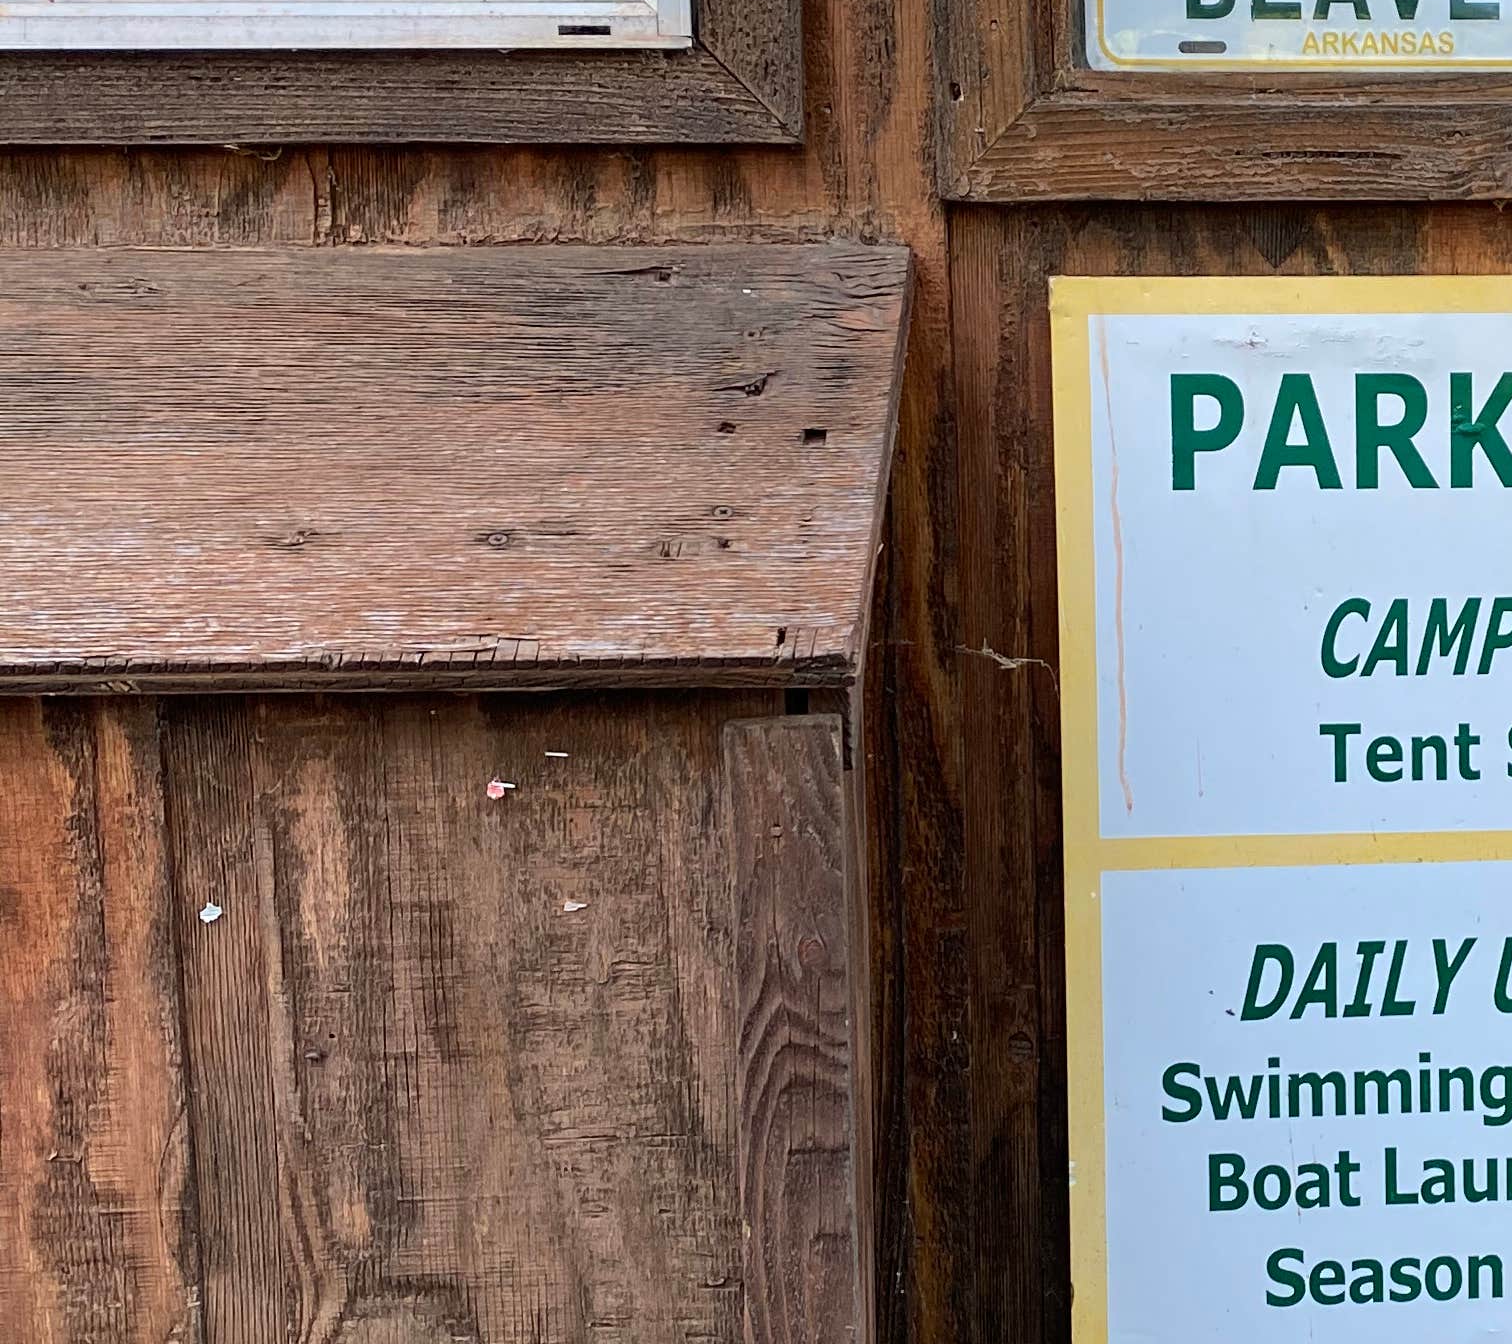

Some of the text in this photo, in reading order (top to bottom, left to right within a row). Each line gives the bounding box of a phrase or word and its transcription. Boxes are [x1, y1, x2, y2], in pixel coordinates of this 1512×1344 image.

[1302, 31, 1455, 55] ARKANSAS
[1319, 722, 1482, 784] Tent
[1241, 937, 1479, 1022] DAILY
[1207, 1150, 1361, 1213] Boat
[1266, 1247, 1505, 1308] Season
